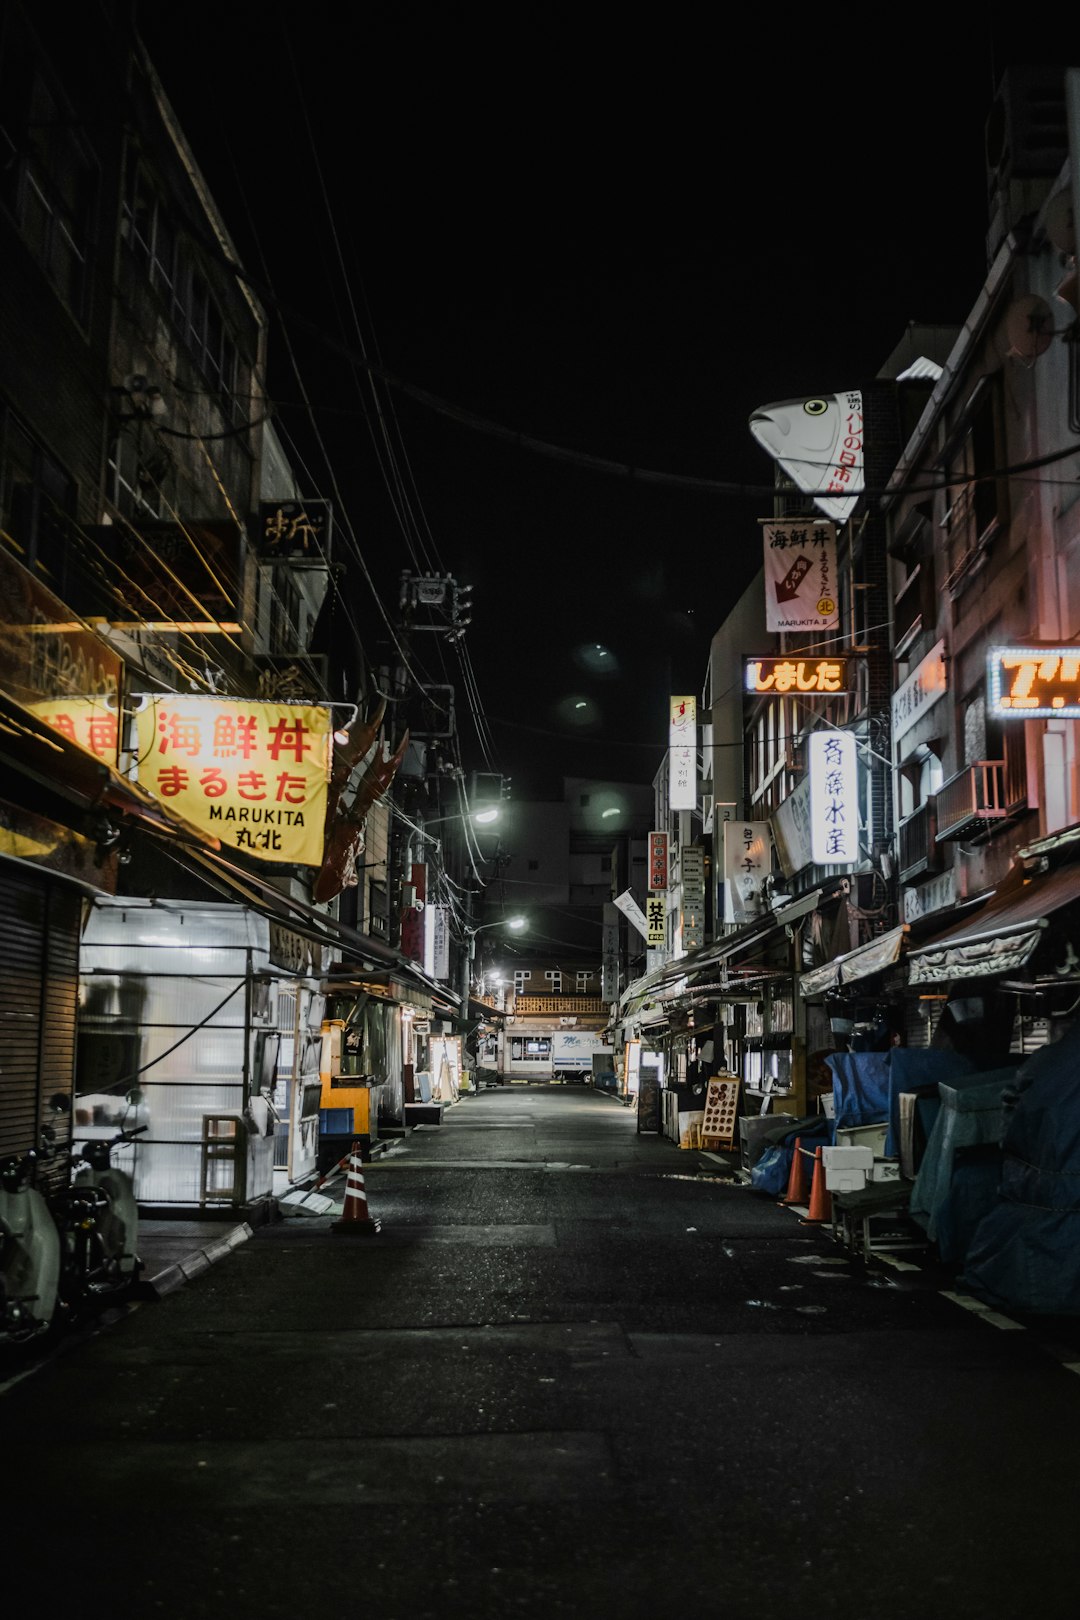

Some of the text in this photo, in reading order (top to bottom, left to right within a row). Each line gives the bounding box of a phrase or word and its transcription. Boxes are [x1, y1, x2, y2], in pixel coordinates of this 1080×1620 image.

[778, 619, 820, 627] MARUKITA
[754, 660, 842, 692] しました
[158, 712, 312, 763] 海鮮丼
[157, 766, 307, 804] まるきた
[209, 805, 306, 827] MARUKITA
[236, 827, 282, 851] 丸北
[649, 901, 664, 931] 茶
